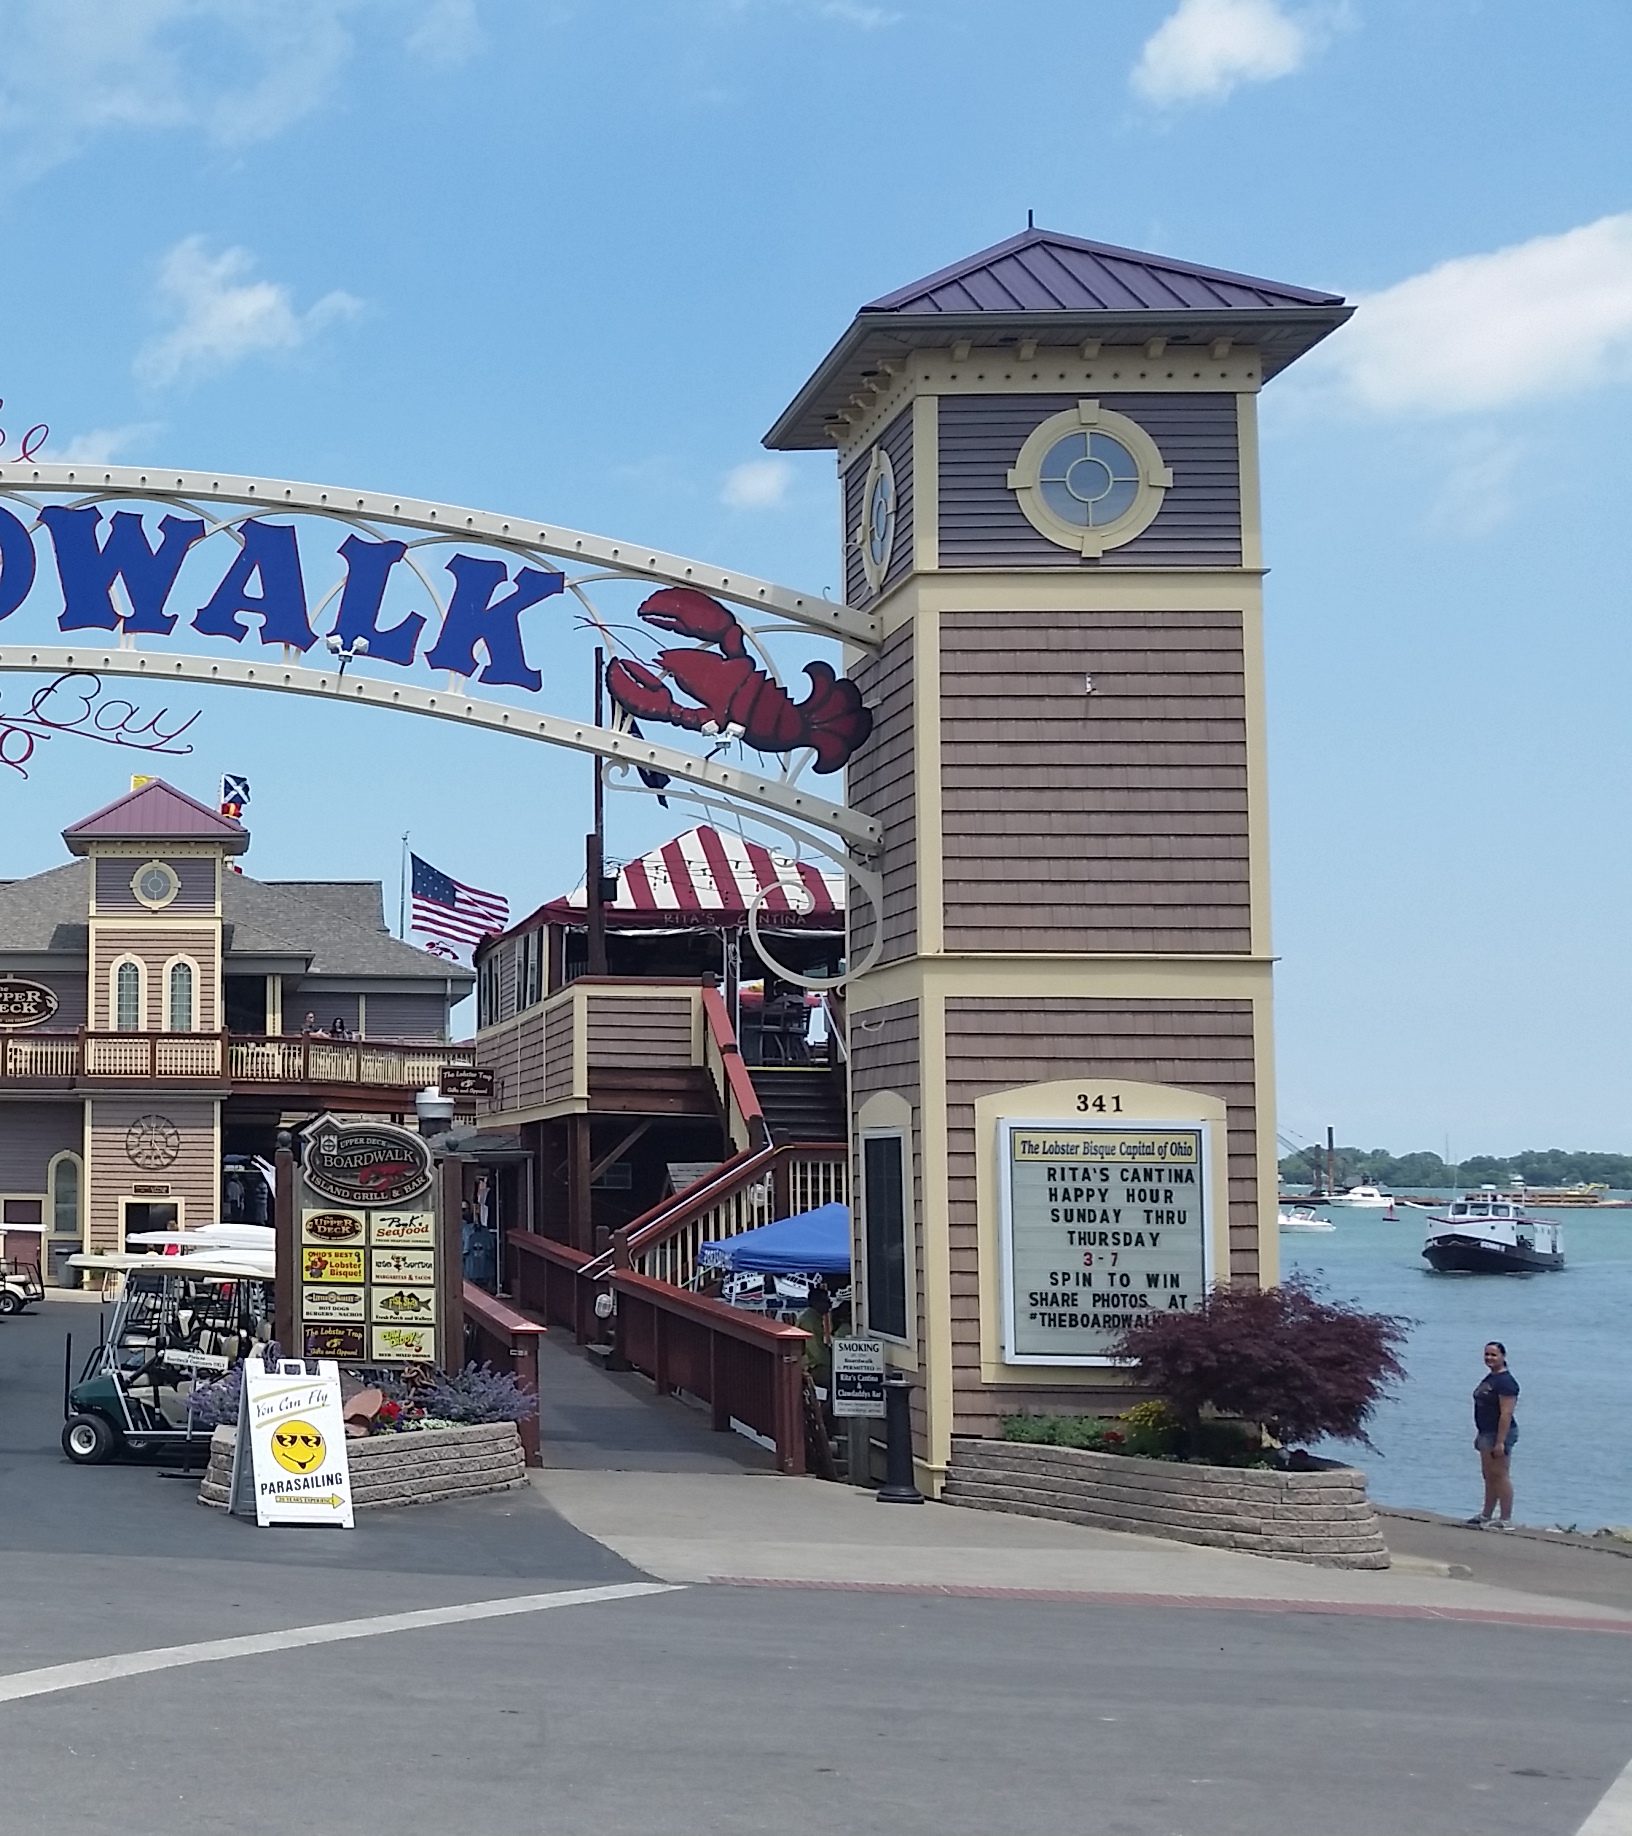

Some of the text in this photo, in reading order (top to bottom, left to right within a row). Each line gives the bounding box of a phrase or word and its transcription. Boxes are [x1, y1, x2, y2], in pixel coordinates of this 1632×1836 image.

[23, 671, 203, 749] Bay
[664, 914, 806, 924] RITA'S CNTINA
[1076, 1094, 1123, 1112] 341
[340, 1138, 387, 1149] UPPER DECK
[1021, 1140, 1193, 1159] The Lobster Bisque Capital of Ohio
[324, 1149, 414, 1168] BOARDWALK
[1047, 1166, 1195, 1184] RITA'S CANTINA
[311, 1175, 349, 1197] ISLAND
[353, 1192, 388, 1200] GRILL
[404, 1176, 426, 1193] BAR
[1048, 1188, 1174, 1204] HAPPY HOUR
[1050, 1208, 1188, 1224] SUNDAY THRU
[376, 1224, 429, 1237] Seafood
[1068, 1230, 1160, 1246] THURSDAY
[330, 1269, 361, 1278] Bisque!
[1050, 1272, 1180, 1288] SPIN TO WIN
[1029, 1292, 1188, 1309] SHARE PHOTOS AT
[305, 1327, 362, 1340] The Lobster Trap
[838, 1343, 879, 1352] SMOKING
[256, 1389, 328, 1417] You Can Fly
[261, 1473, 343, 1495] PARASAILING
